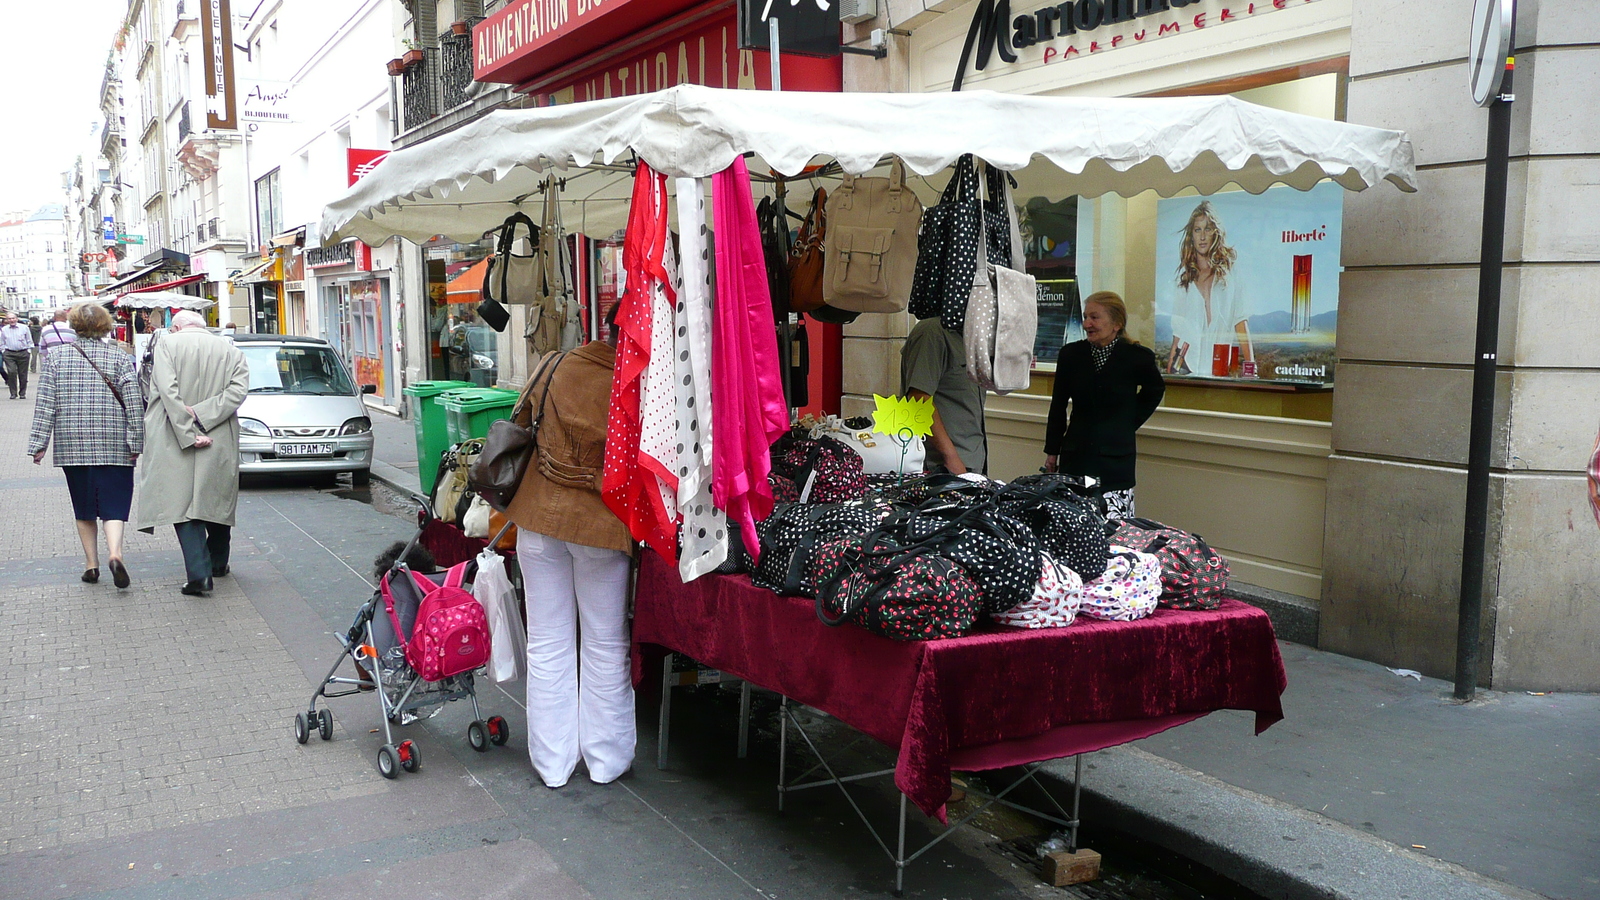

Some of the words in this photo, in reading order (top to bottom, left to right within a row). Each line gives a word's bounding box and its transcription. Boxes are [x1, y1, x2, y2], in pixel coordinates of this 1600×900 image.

[478, 0, 569, 70] ALIMENTATION
[1043, 0, 1311, 64] PARFUMERIE
[951, 0, 1200, 93] Marion
[214, 36, 224, 93] MINUTE
[244, 110, 290, 120] BIJOUTERIE
[1281, 224, 1327, 244] liberté
[1037, 290, 1064, 301] démon
[1274, 363, 1327, 377] cacharel
[280, 444, 298, 455] 981
[300, 444, 318, 455] PAM
[319, 443, 332, 454] 75
